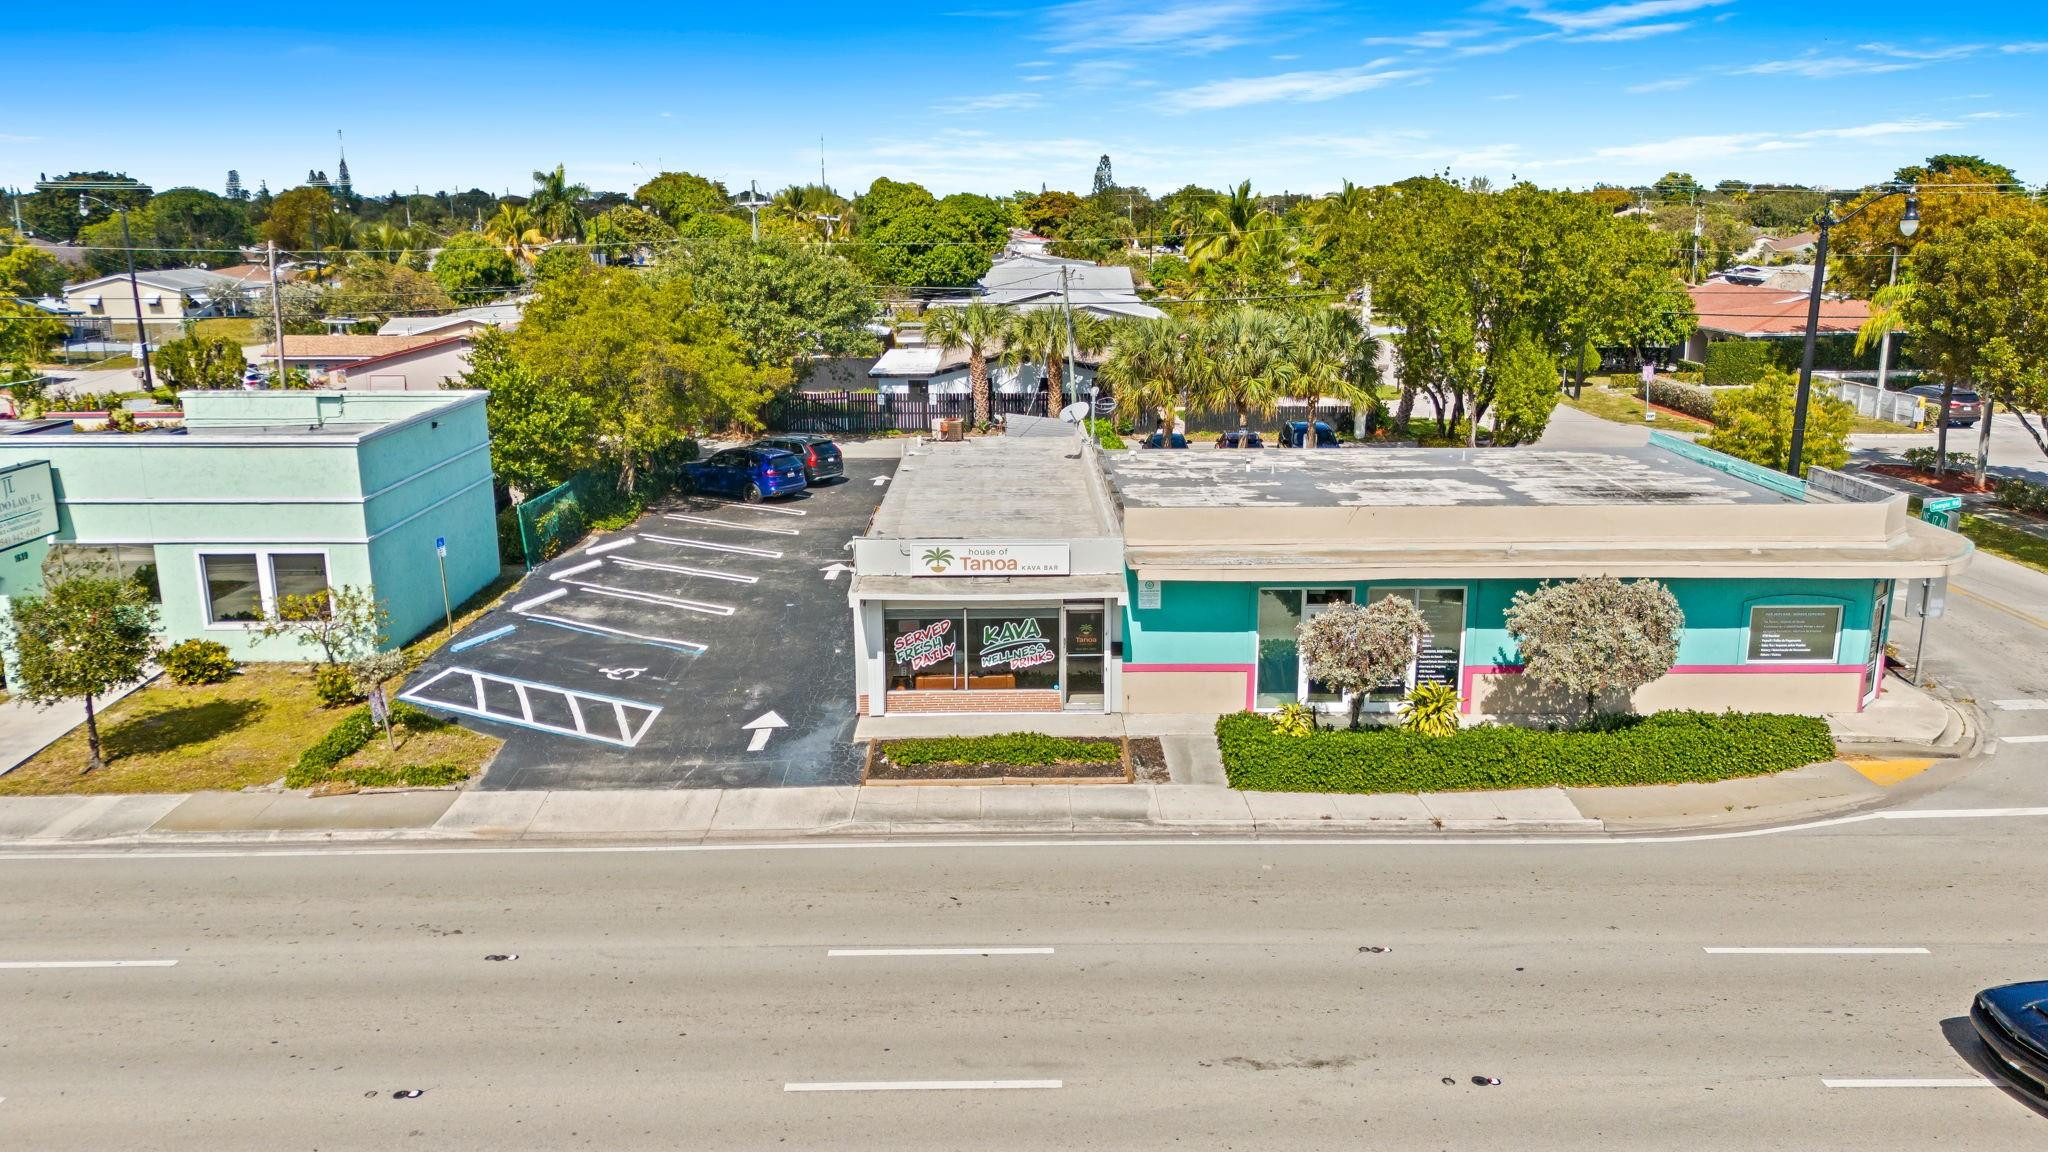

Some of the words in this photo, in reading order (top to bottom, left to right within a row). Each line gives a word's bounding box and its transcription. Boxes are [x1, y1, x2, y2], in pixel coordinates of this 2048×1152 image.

[960, 557, 1018, 571] Tanoa
[968, 548, 996, 556] house
[998, 548, 1008, 556] of
[894, 619, 951, 650] SERVED
[983, 618, 1041, 645] KAVA
[896, 637, 942, 664] FRESH
[912, 642, 955, 670] DAILY
[981, 642, 1045, 668] WELLNESS
[1009, 649, 1055, 670] DRINKS
